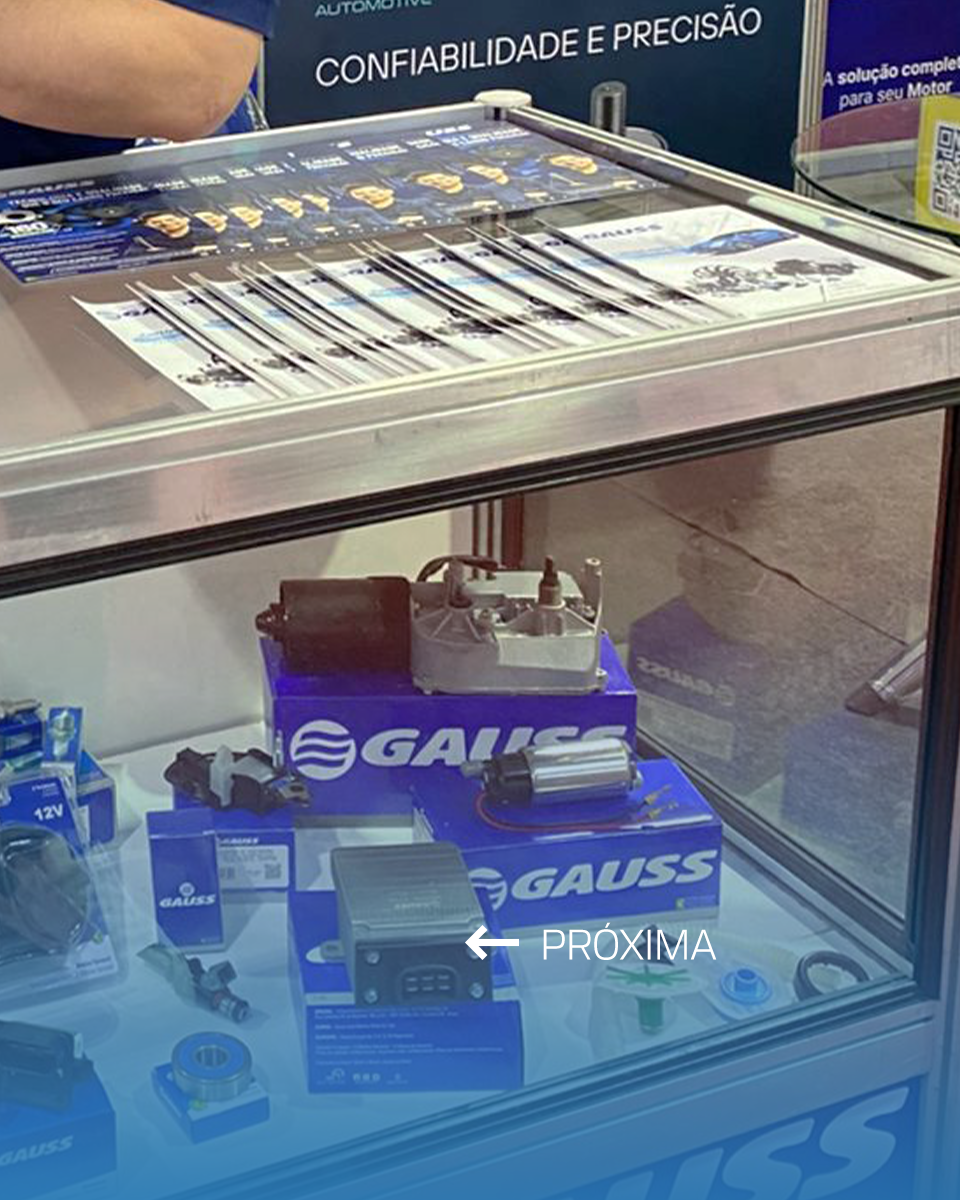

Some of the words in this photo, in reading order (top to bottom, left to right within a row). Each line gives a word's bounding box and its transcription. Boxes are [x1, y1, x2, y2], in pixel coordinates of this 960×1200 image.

[315, 29, 578, 87] CONFIABILIDADE
[587, 25, 607, 54] E
[614, 3, 763, 51] PRECISÃO
[822, 71, 834, 87] A
[837, 63, 898, 86] solução
[839, 90, 873, 111] para
[876, 86, 903, 102] seu
[906, 80, 952, 99] Motor
[34, 803, 64, 822] 12V
[511, 850, 718, 900] GAUSS
[159, 894, 216, 908] GAUSS
